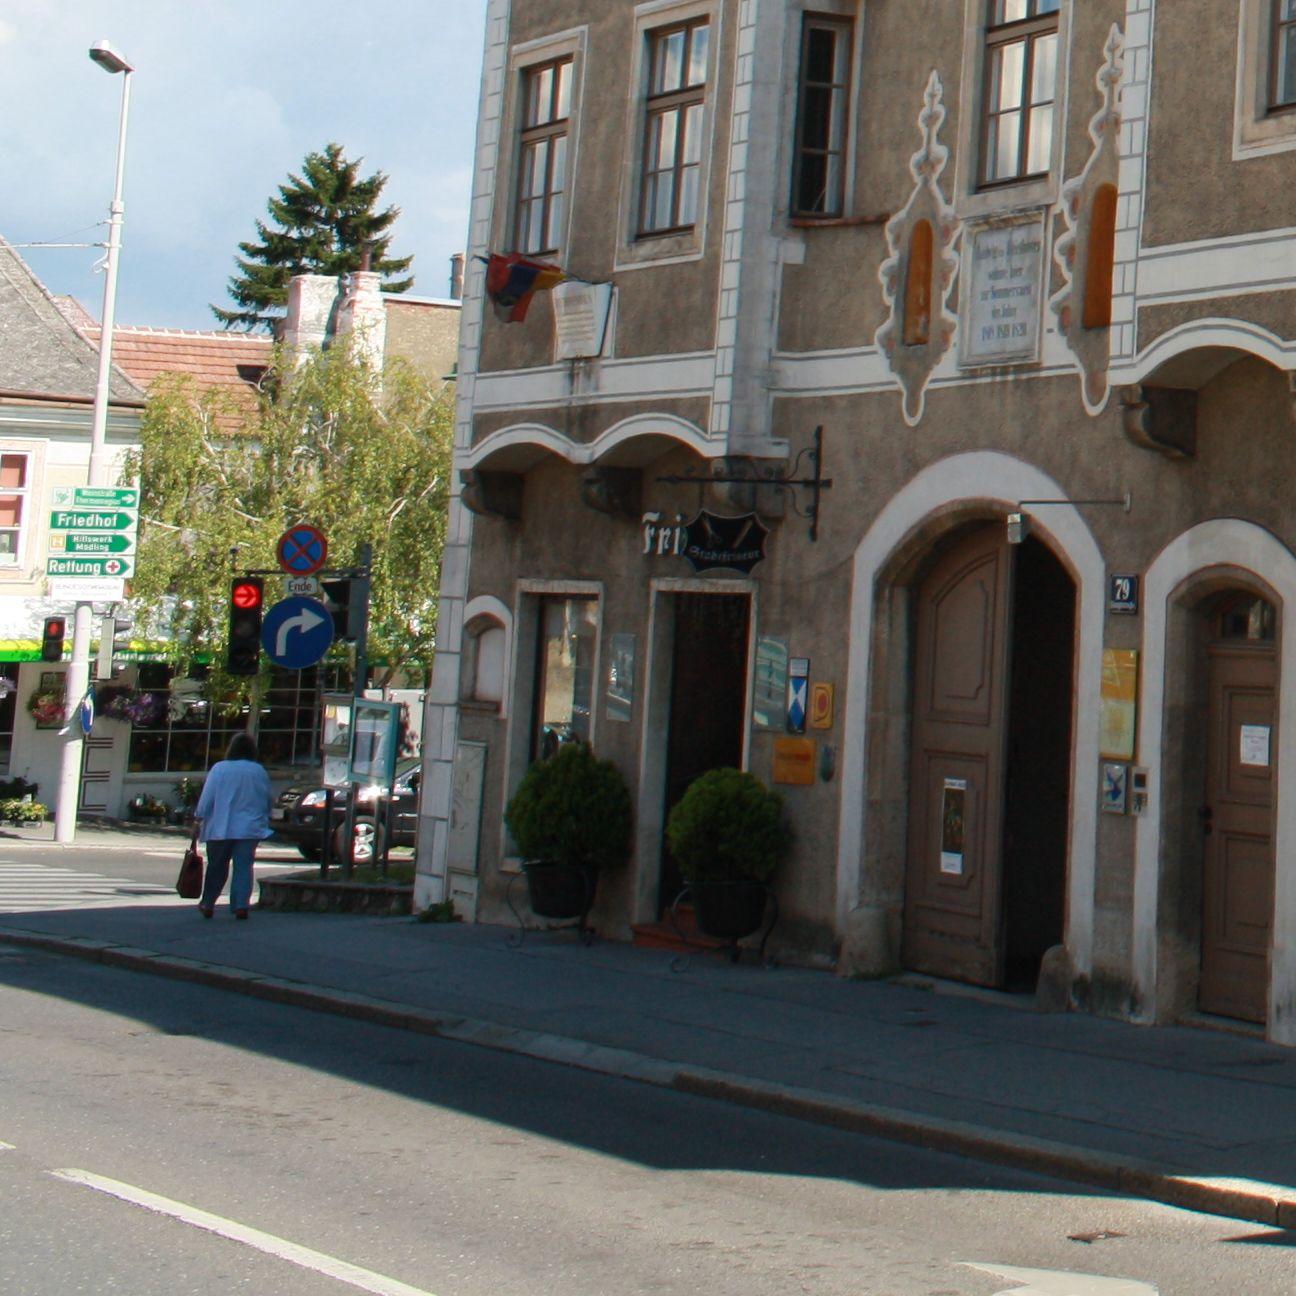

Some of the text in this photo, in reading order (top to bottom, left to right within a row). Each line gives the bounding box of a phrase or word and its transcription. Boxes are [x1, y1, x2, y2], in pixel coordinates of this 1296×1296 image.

[57, 512, 118, 528] Friedhof
[49, 559, 101, 576] Rettung
[1115, 578, 1131, 601] 79
